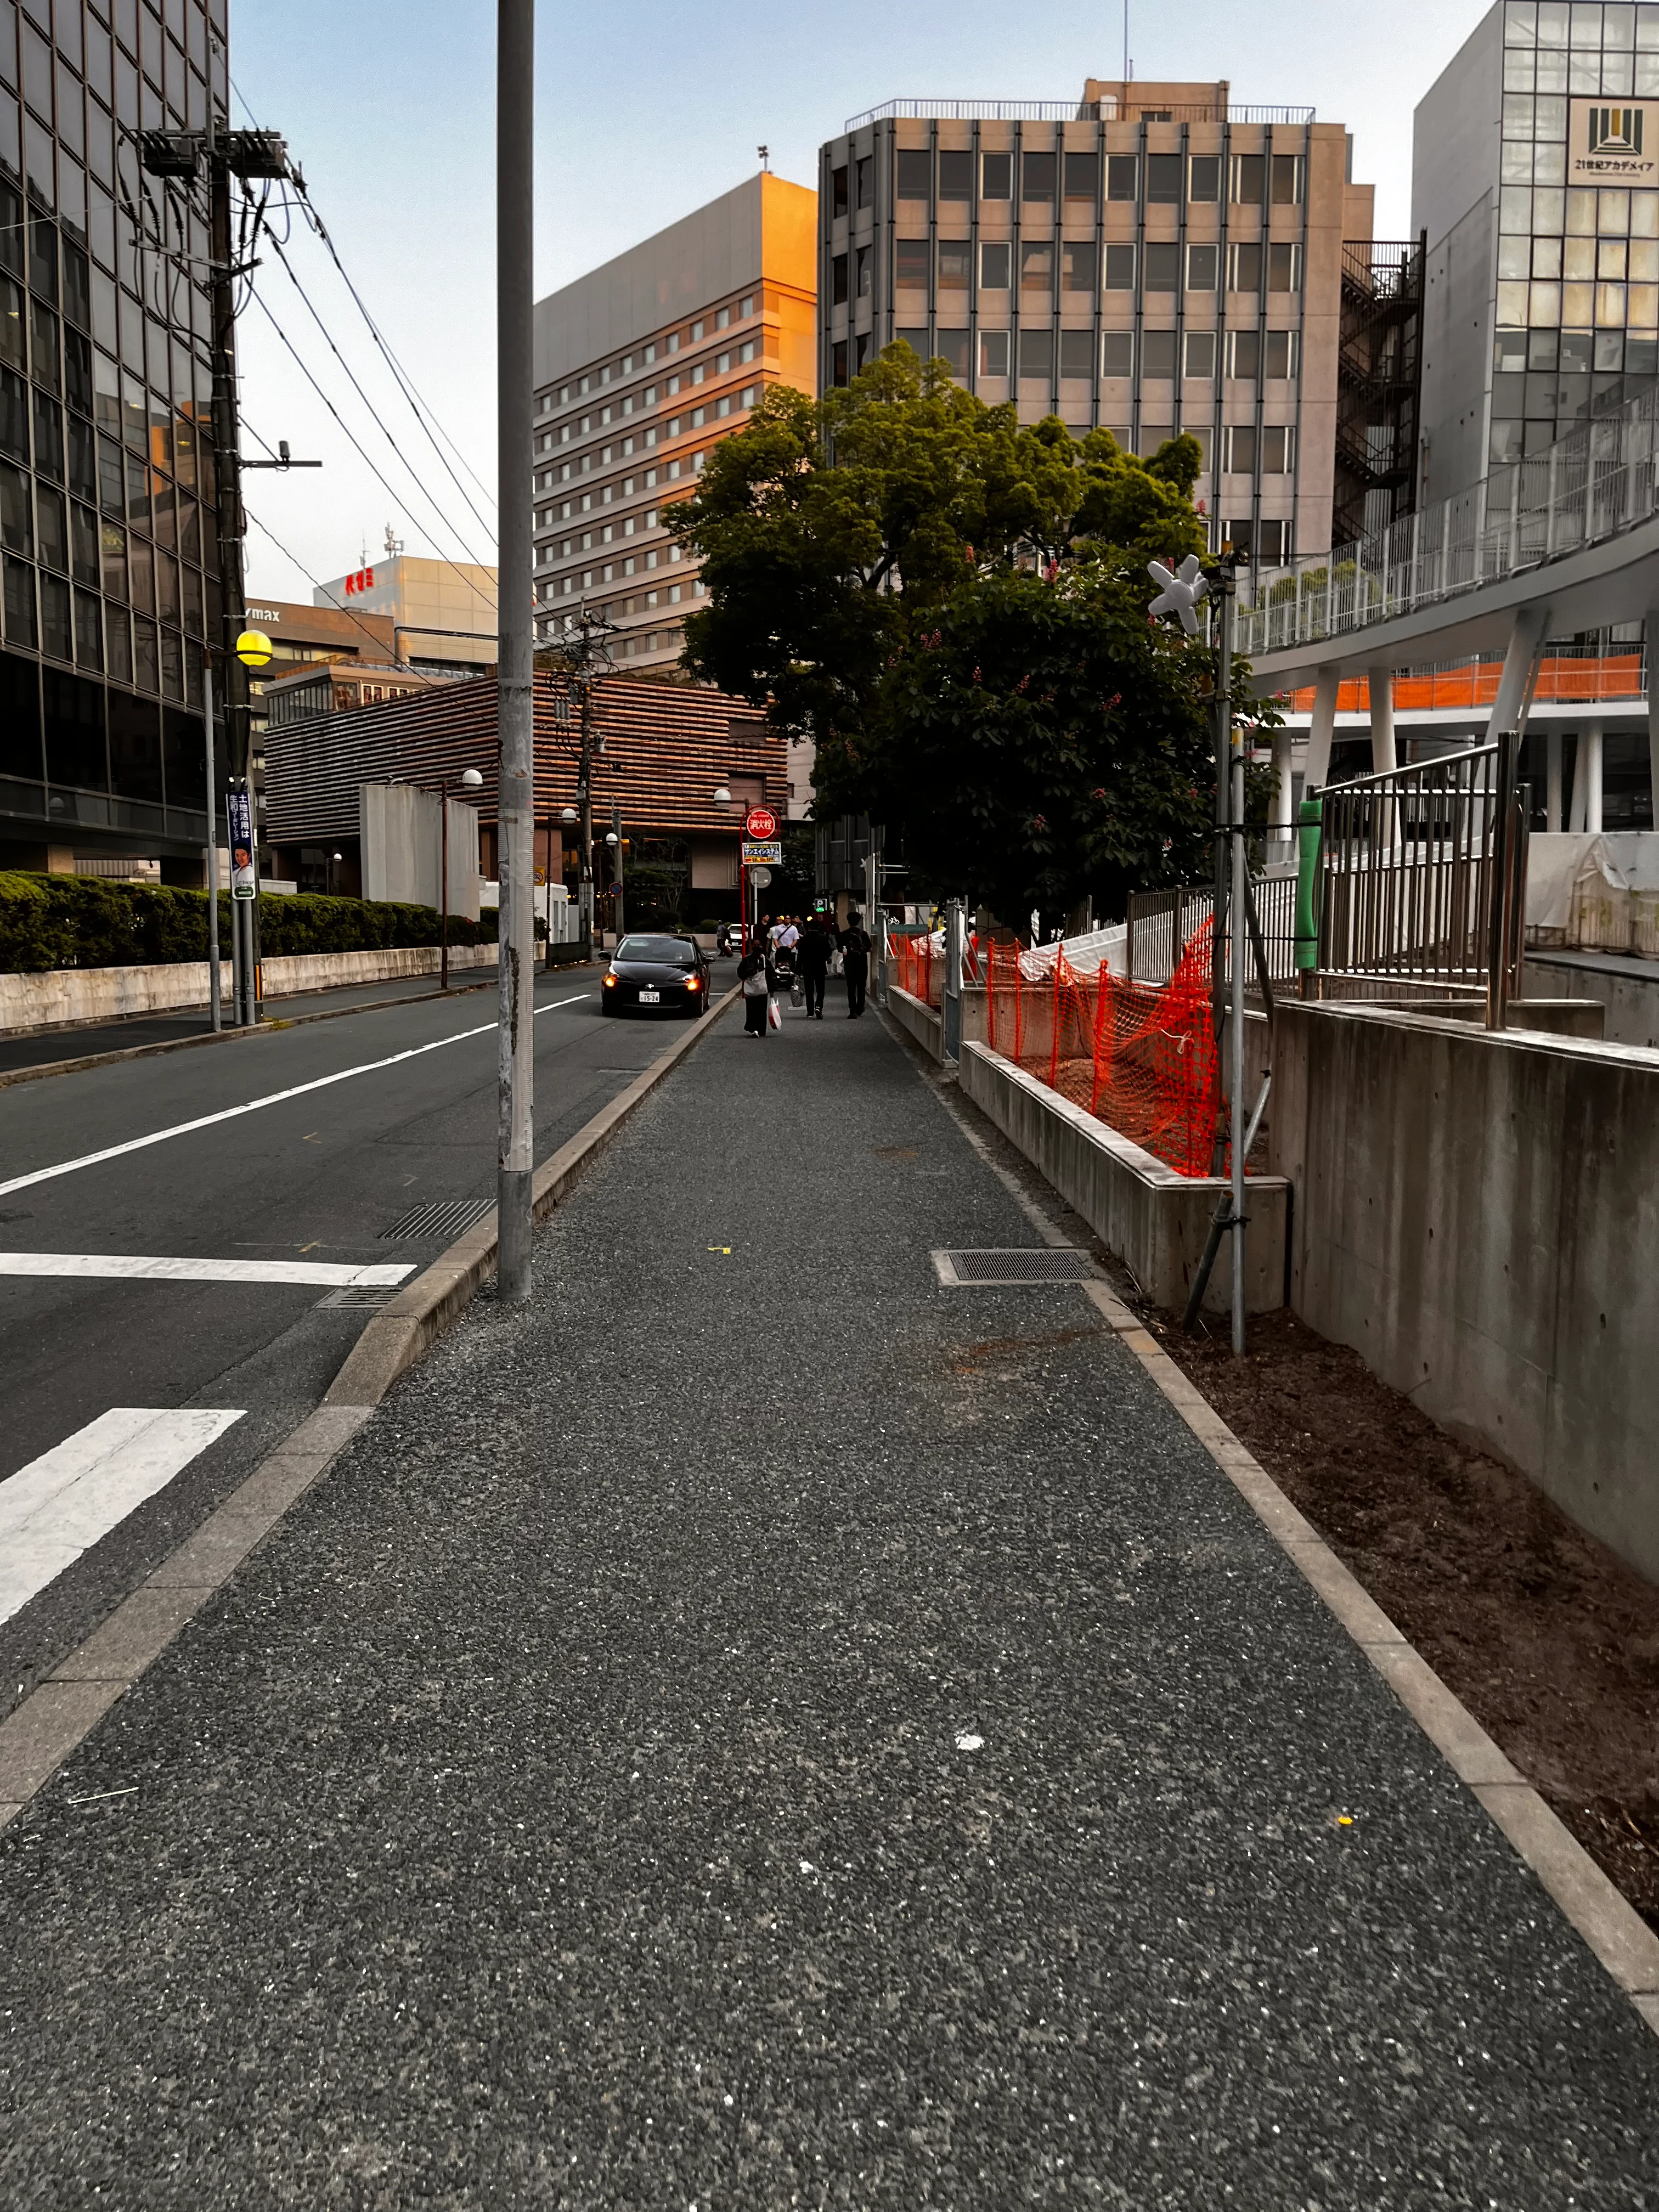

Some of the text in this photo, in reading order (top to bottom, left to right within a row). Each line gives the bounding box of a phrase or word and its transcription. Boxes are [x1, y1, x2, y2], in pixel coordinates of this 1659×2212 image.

[1575, 159, 1655, 171] 21世紀アカデメイア
[238, 794, 250, 839] 土地活用は
[749, 819, 772, 830] 消火栓
